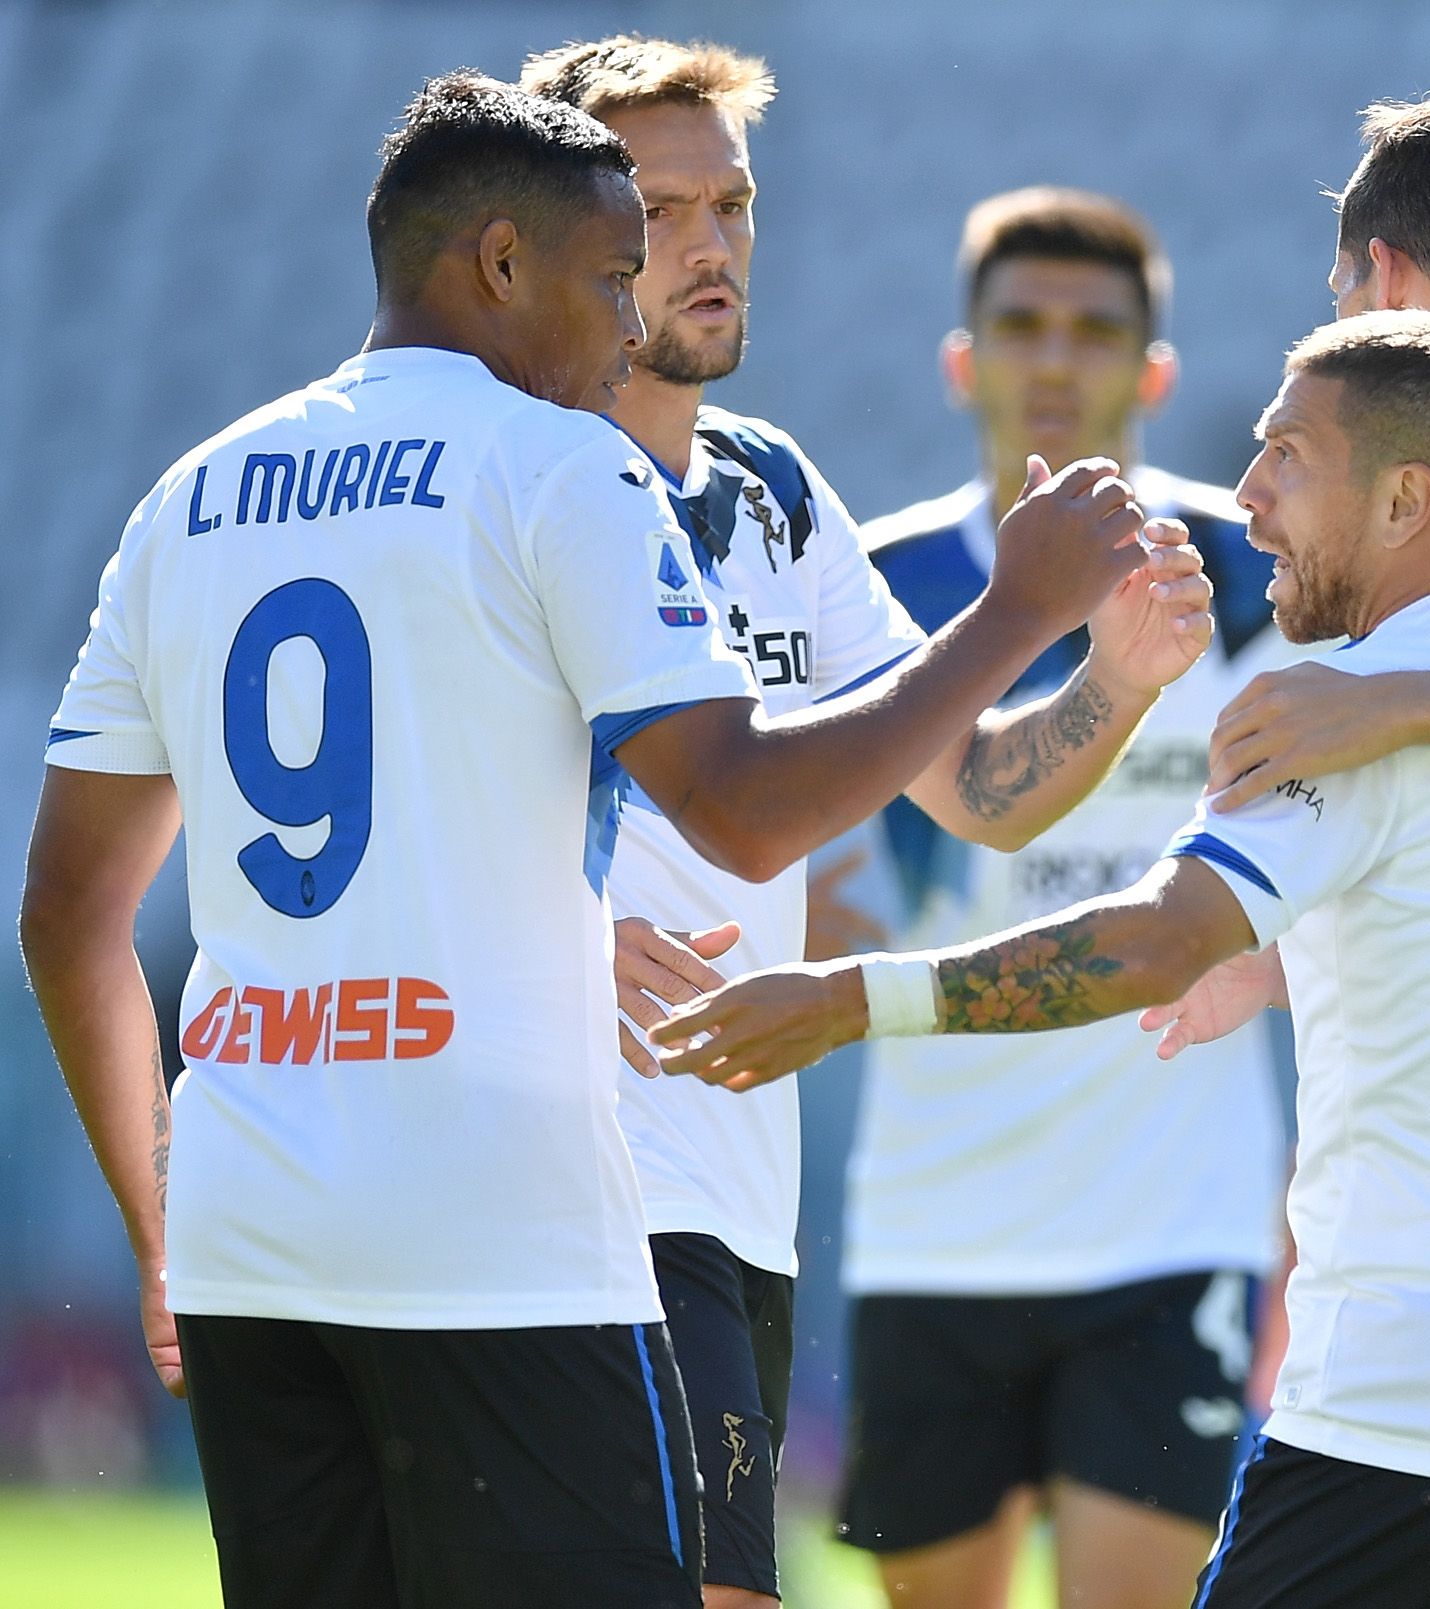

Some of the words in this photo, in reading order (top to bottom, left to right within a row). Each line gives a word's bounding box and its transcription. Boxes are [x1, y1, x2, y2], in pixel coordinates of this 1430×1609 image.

[188, 465, 222, 536] L.
[236, 439, 445, 525] MURIEL
[661, 593, 687, 603] SERIE
[691, 594, 698, 603] A
[224, 577, 373, 918] 9
